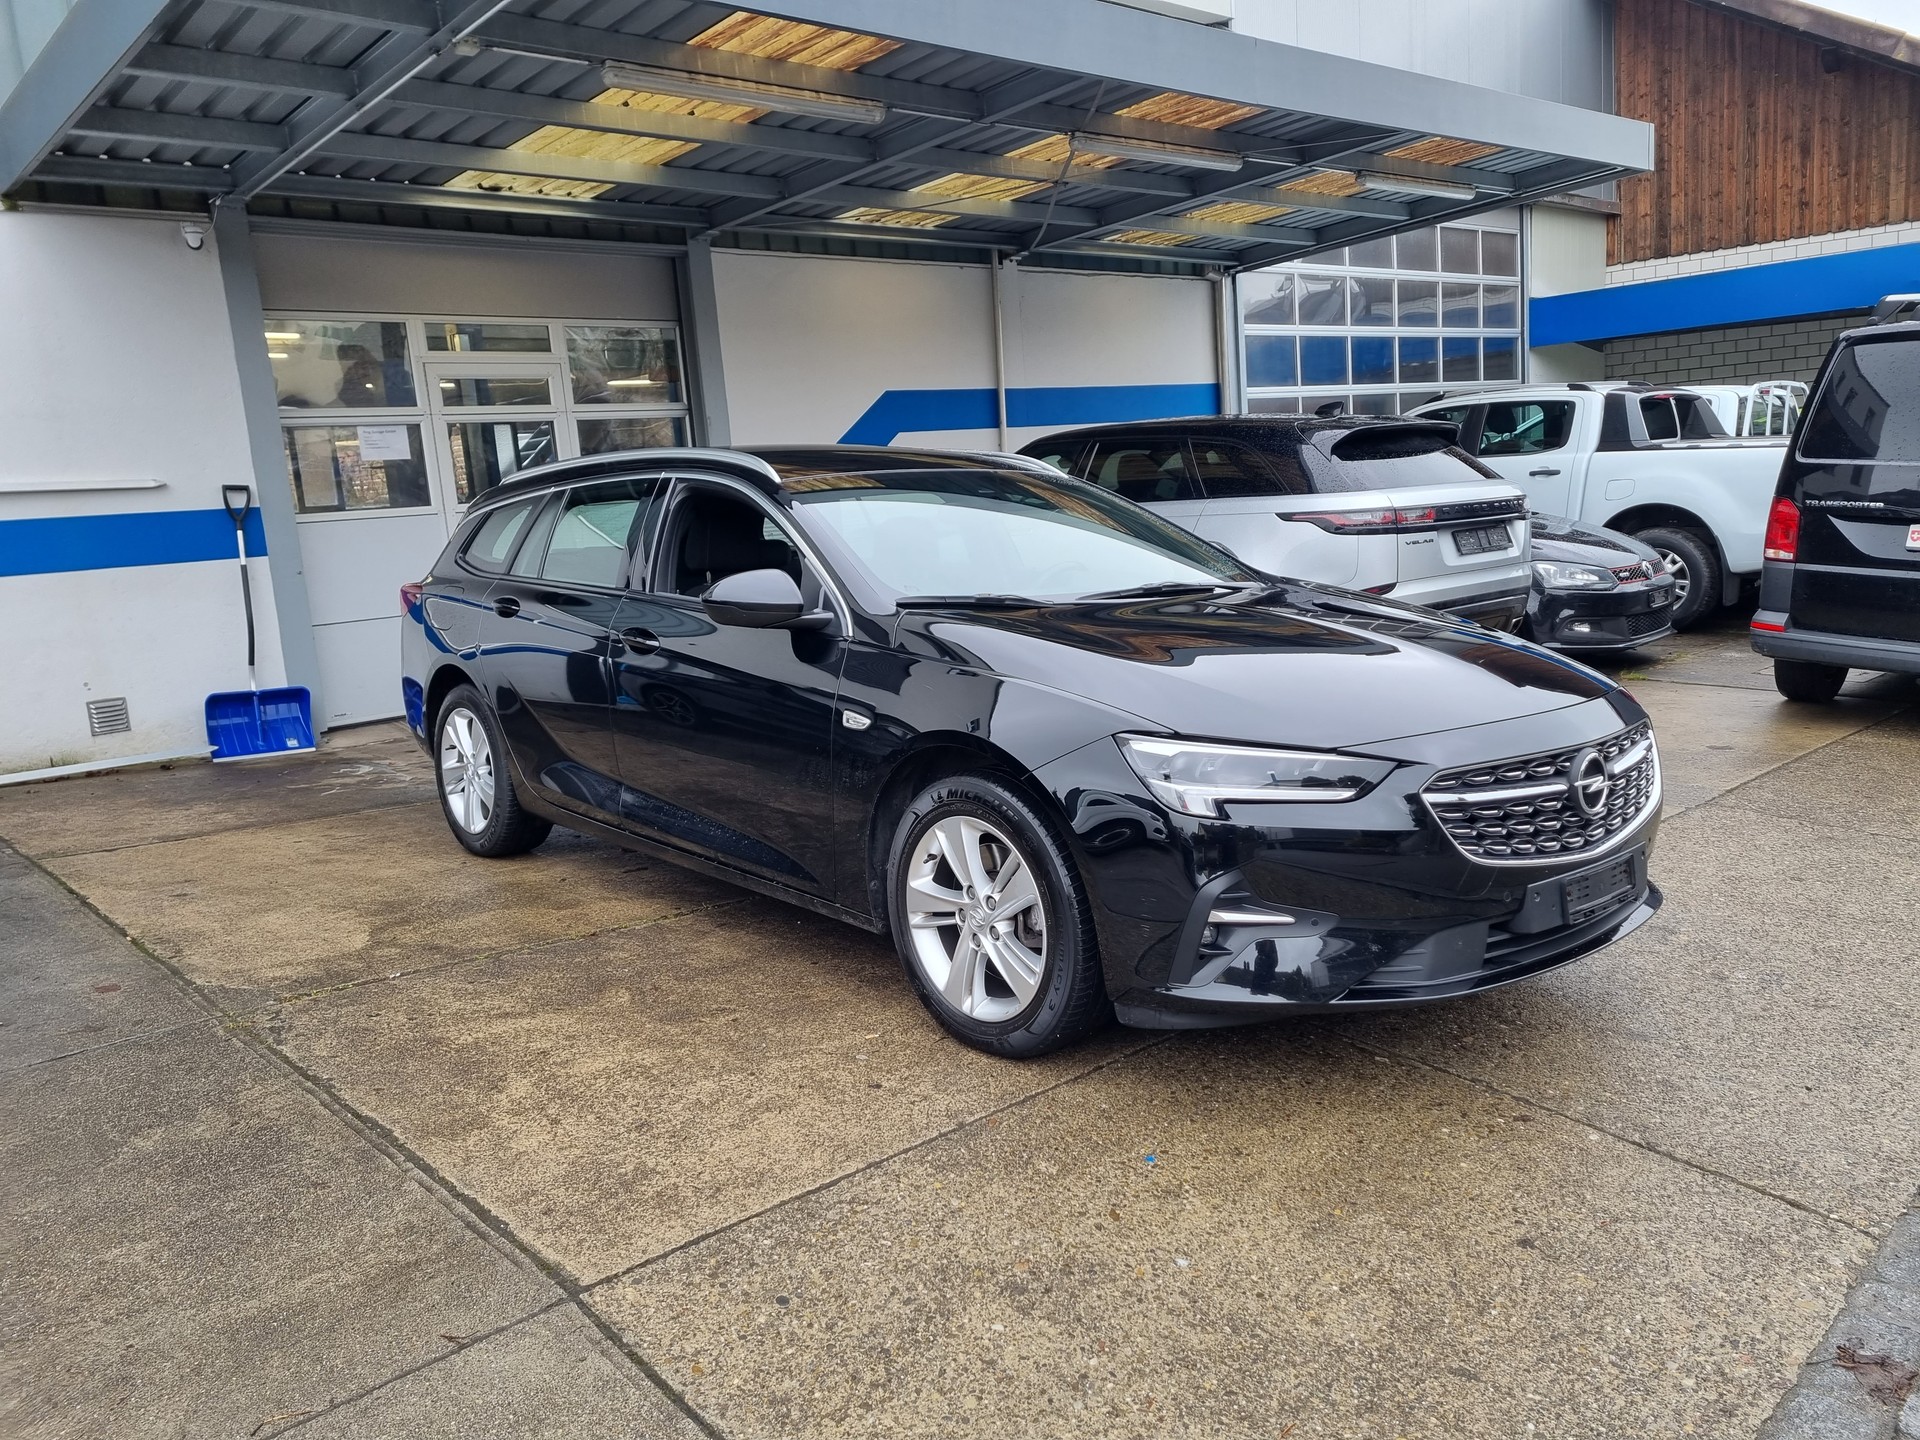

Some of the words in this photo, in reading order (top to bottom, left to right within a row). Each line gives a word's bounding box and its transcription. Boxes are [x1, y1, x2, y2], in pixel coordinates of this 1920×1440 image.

[1442, 503, 1490, 516] RANGE
[1804, 499, 1885, 509] TRANSPORTER
[1405, 538, 1434, 546] VELAR
[946, 787, 1019, 823] MICHELIN
